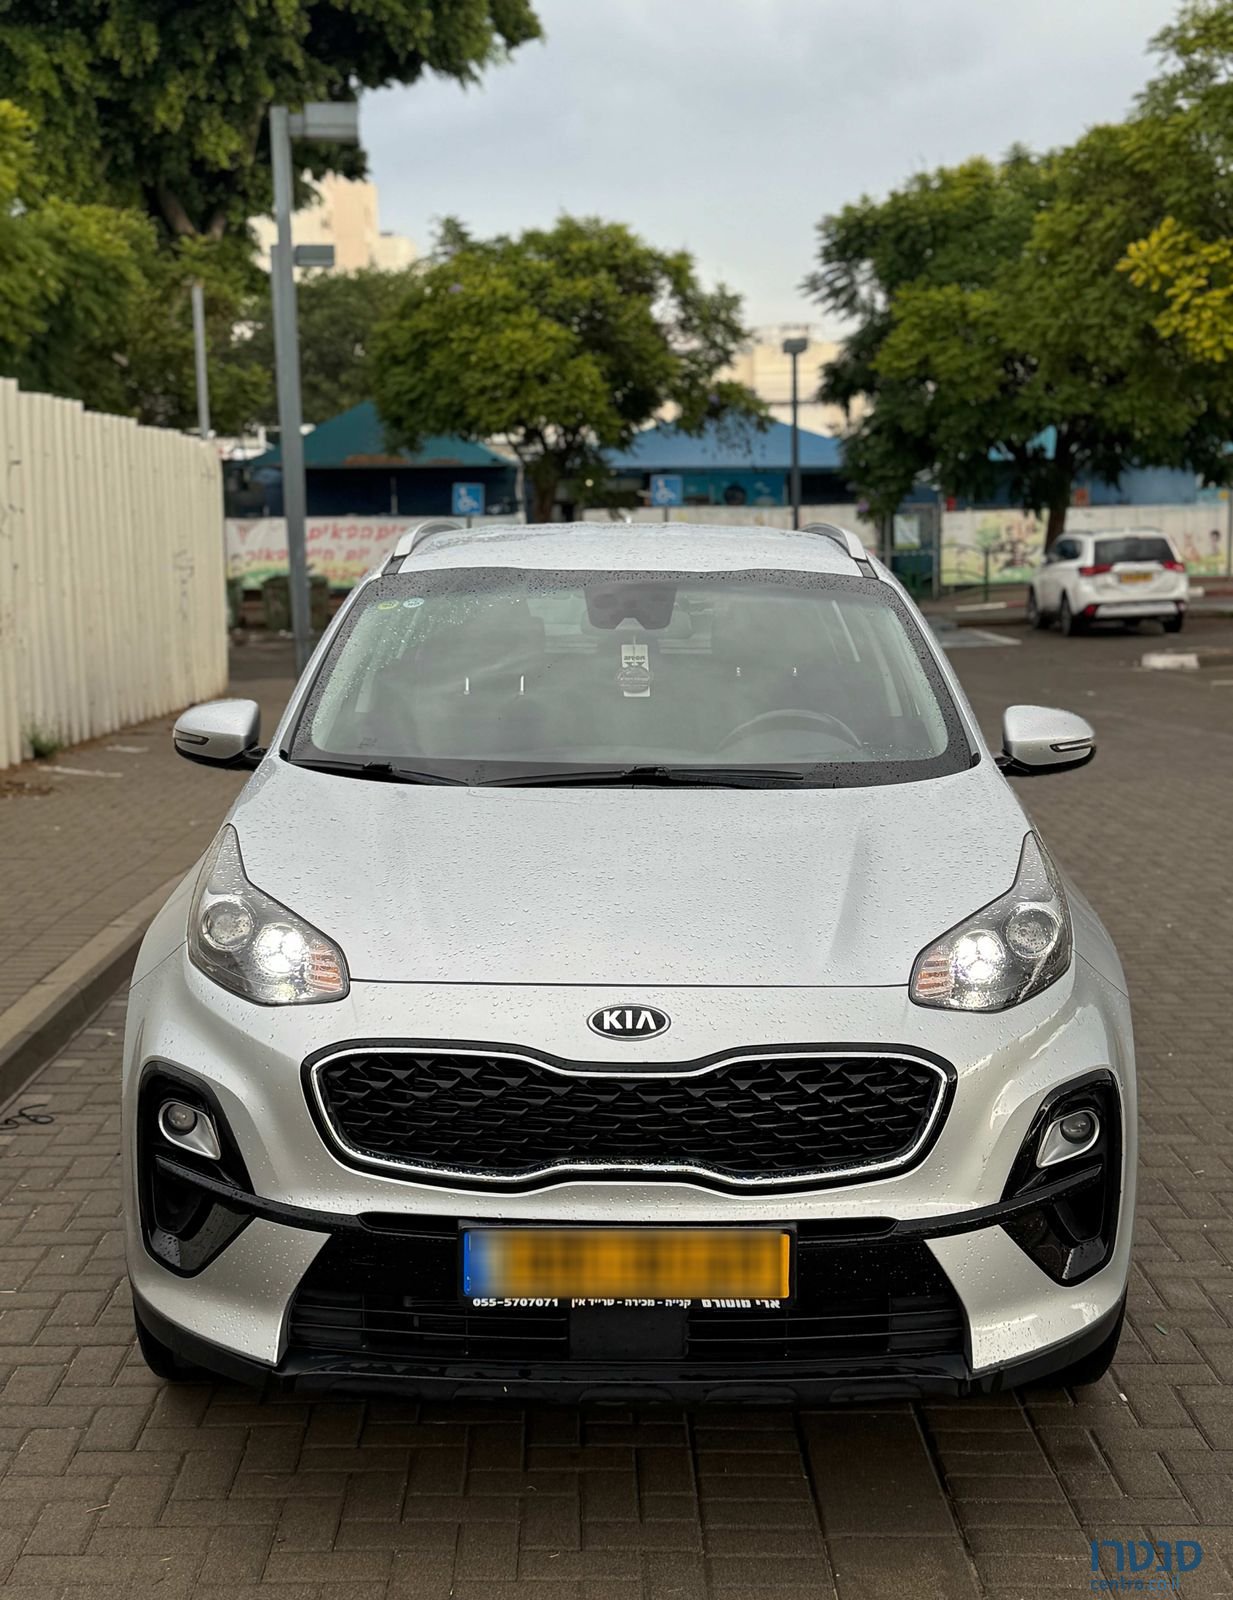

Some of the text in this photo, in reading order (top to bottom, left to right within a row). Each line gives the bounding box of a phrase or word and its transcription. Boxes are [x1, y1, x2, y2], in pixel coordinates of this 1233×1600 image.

[603, 1009, 657, 1030] KIA
[472, 1297, 559, 1307] 055-5707071
[571, 1298, 586, 1309] אין
[624, 1298, 656, 1307] מכירה
[665, 1298, 692, 1309] קנייה
